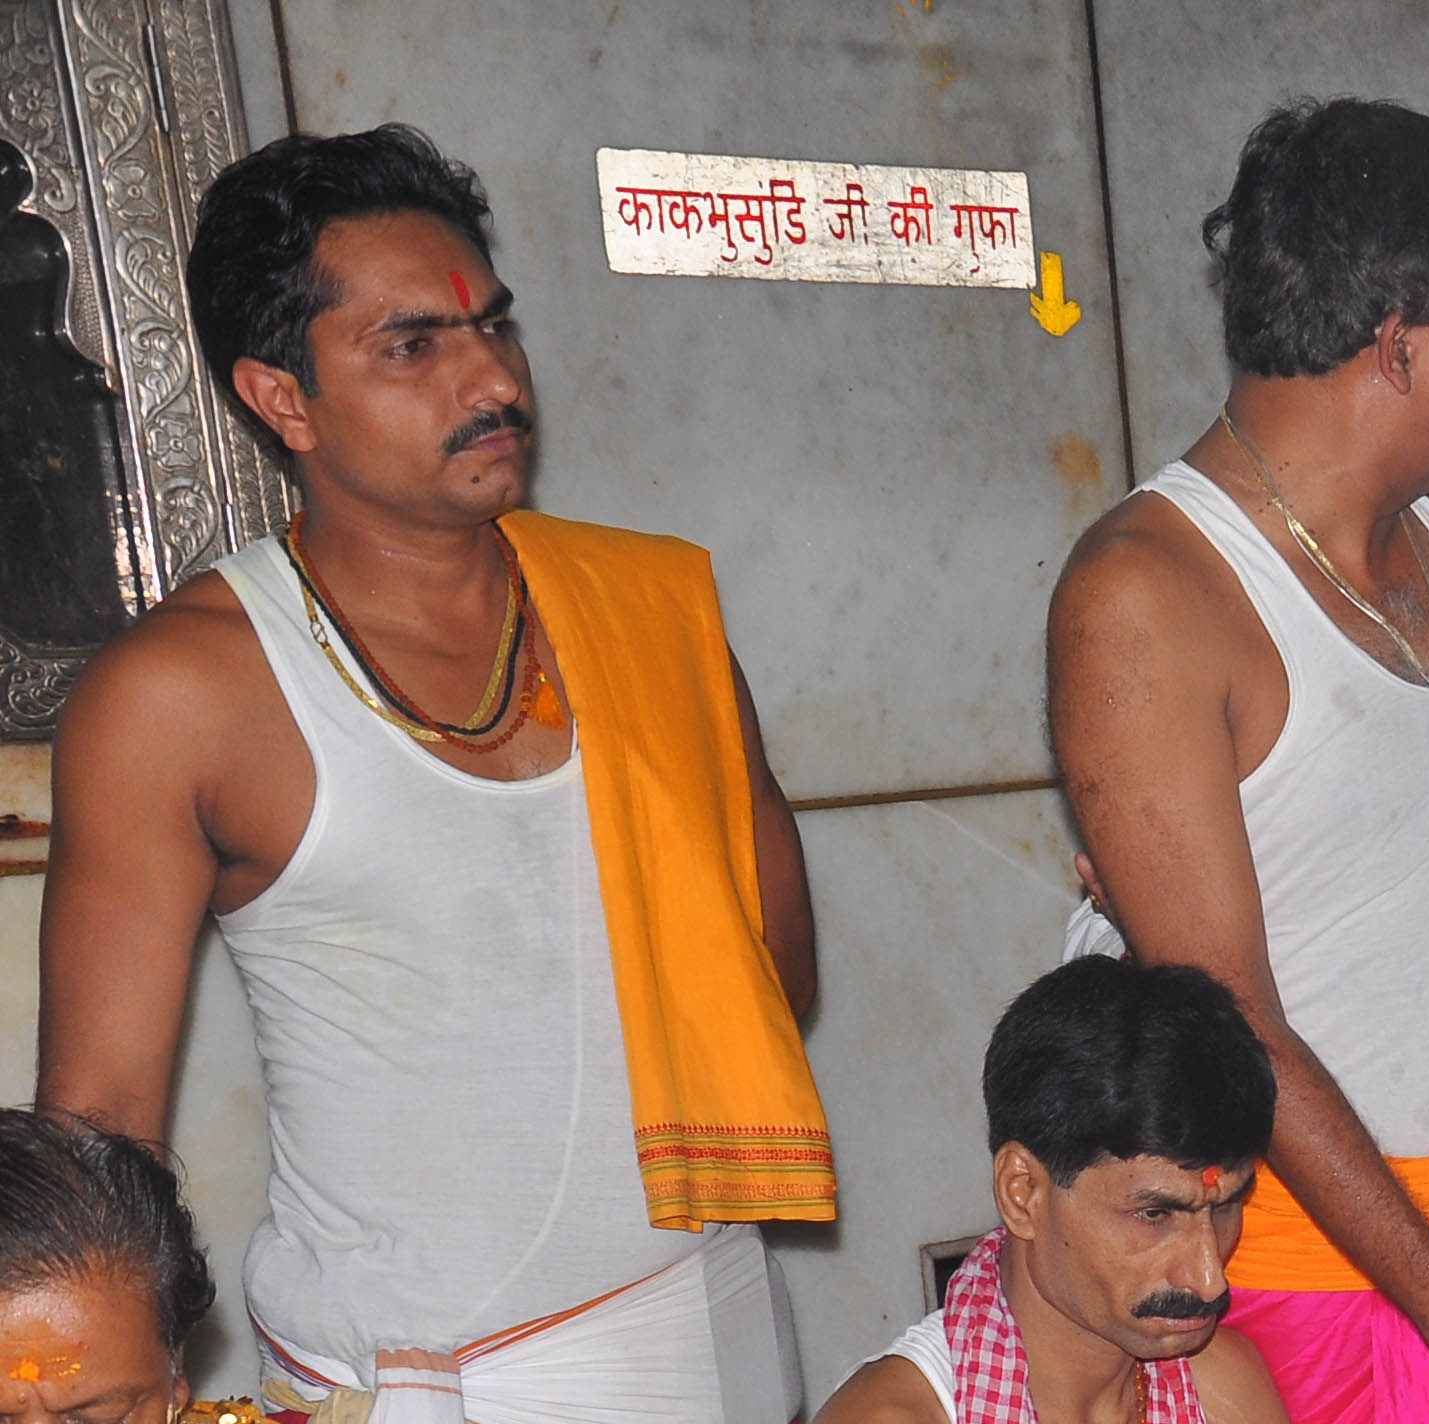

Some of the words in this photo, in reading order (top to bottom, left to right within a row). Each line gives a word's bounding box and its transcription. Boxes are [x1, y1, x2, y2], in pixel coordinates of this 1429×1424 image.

[615, 179, 807, 266] काकभुसुंडि
[822, 183, 870, 247] जी
[887, 185, 935, 246] की
[949, 203, 1020, 274] गुफा
